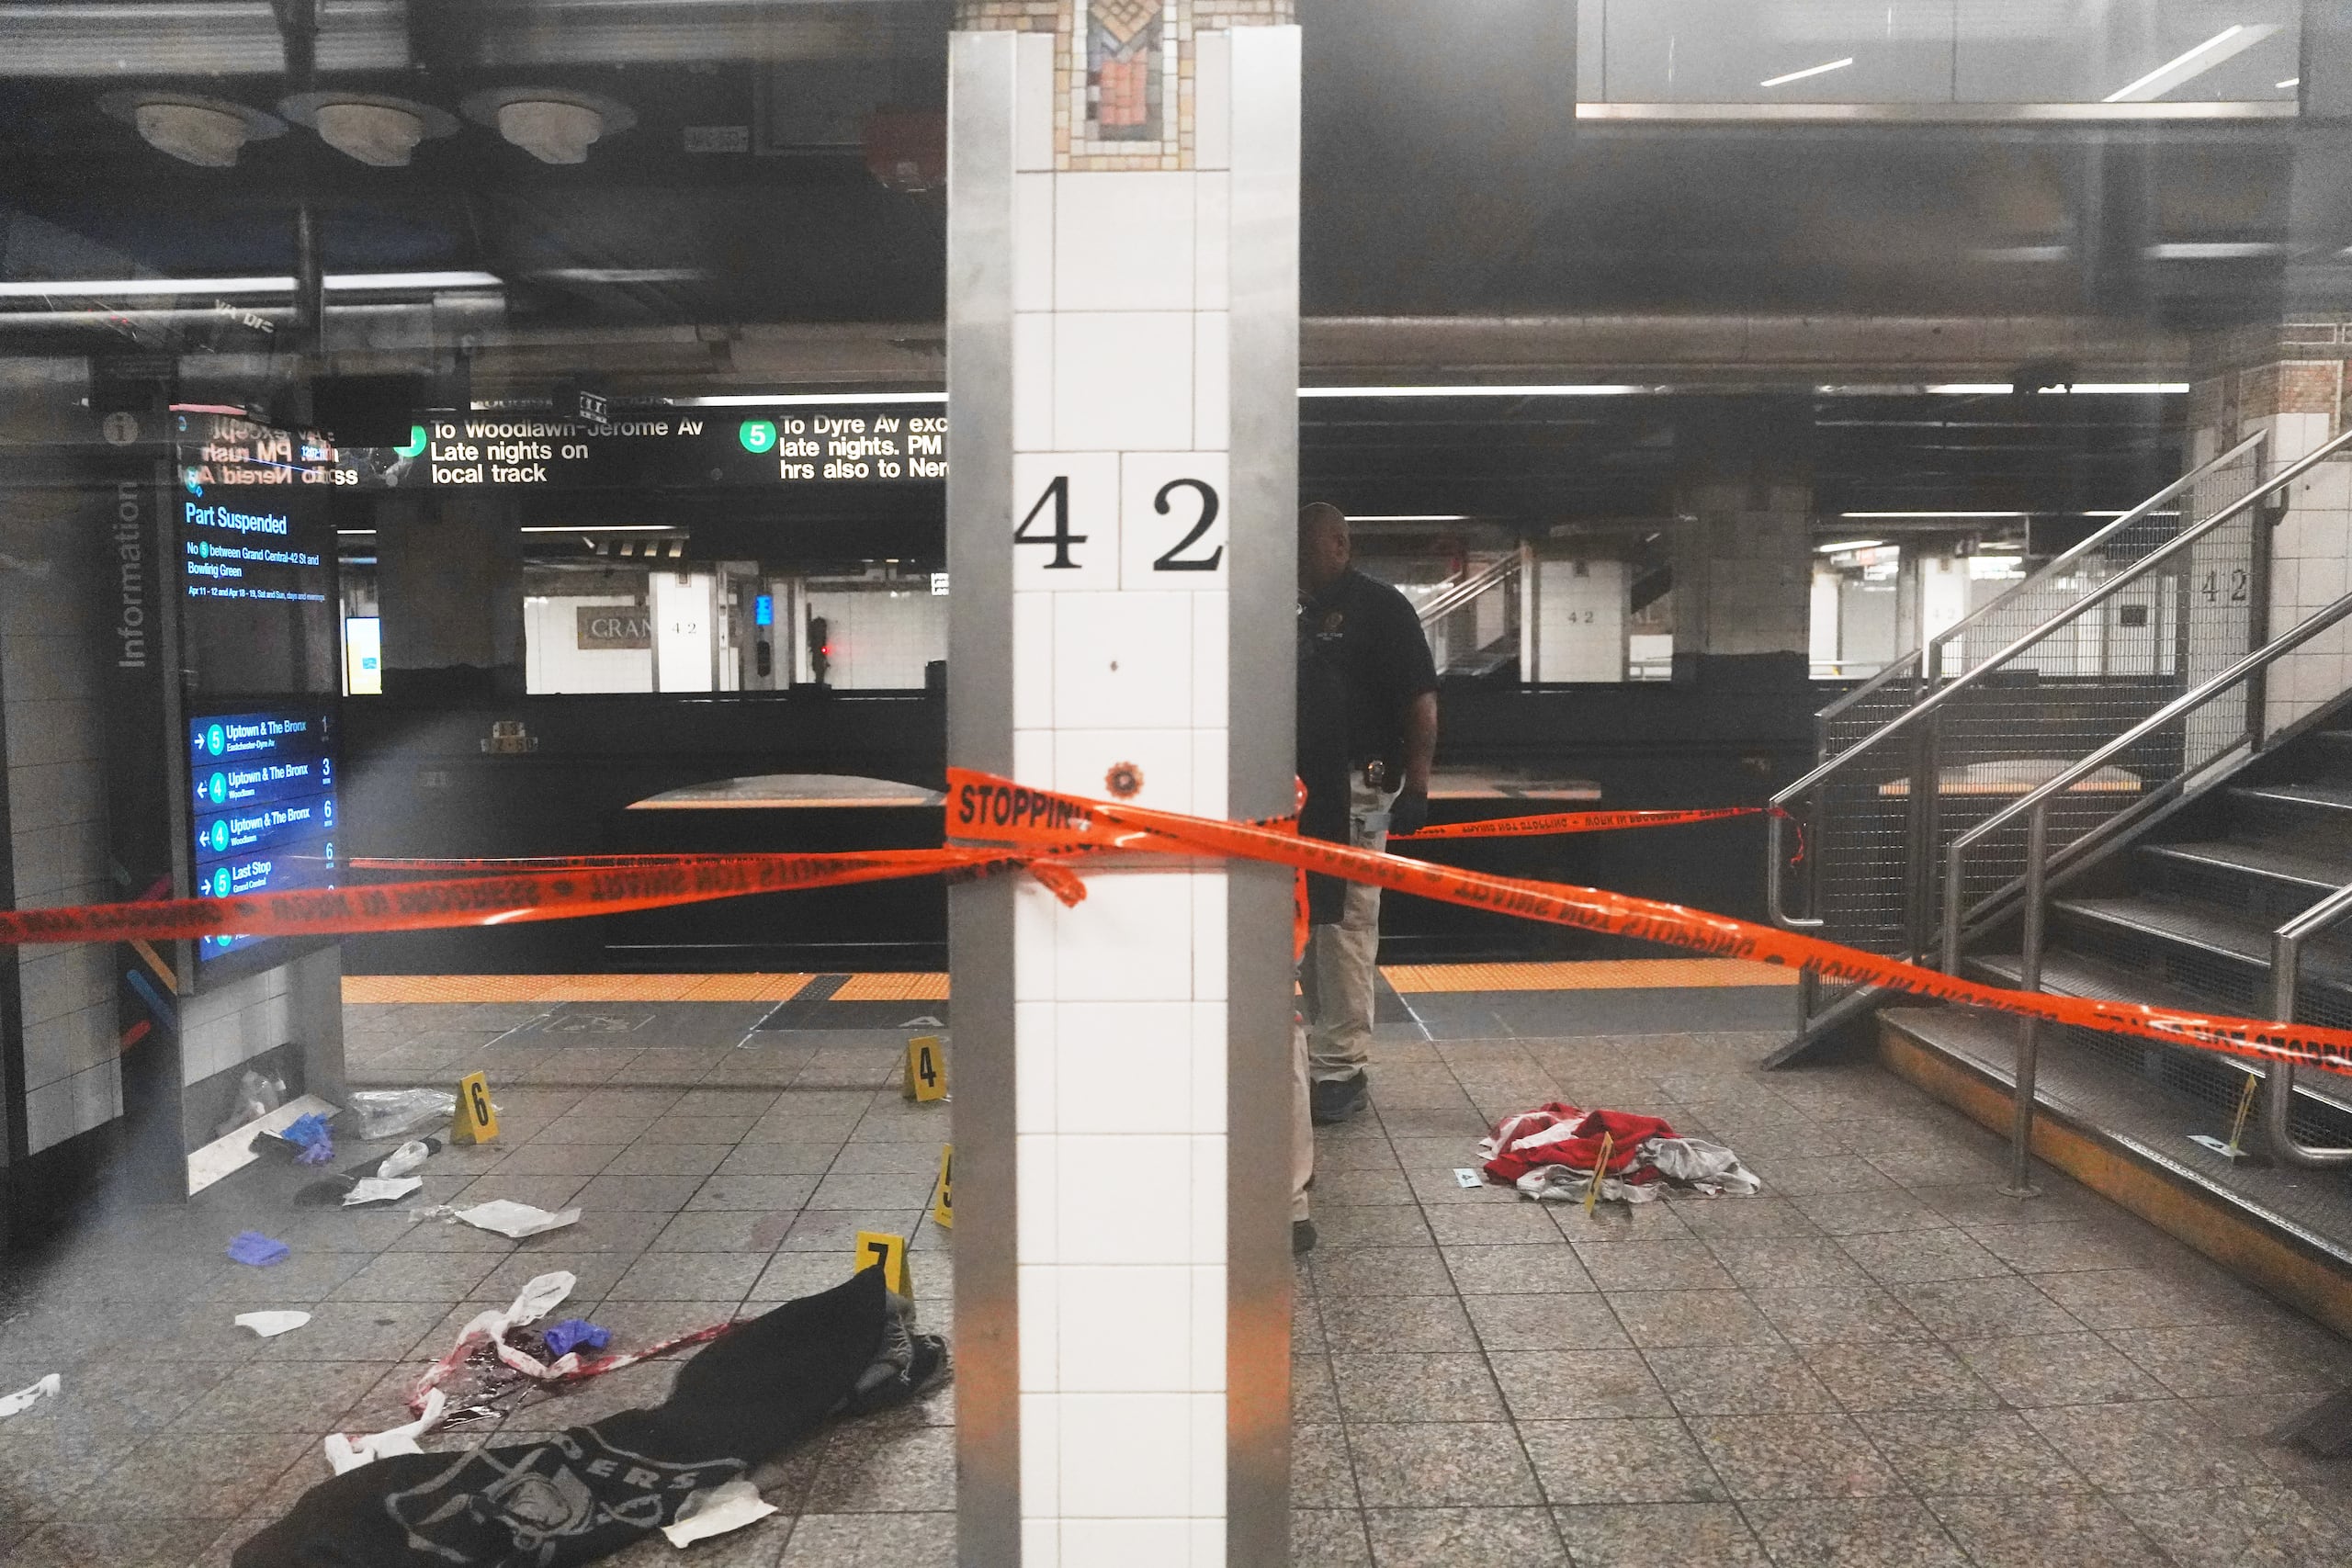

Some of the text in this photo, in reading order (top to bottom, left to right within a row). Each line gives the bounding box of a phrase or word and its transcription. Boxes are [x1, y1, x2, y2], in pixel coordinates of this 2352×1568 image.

[677, 418, 704, 436] Av
[750, 424, 765, 446] 5
[779, 415, 805, 434] To
[813, 415, 865, 436] Dyre
[873, 414, 899, 434] Av
[431, 441, 589, 464] Late nights on
[779, 434, 942, 460] late nights. PM
[431, 463, 548, 483] local track
[780, 457, 949, 479] hrs also to Ner
[186, 502, 288, 535] Part Suspended
[187, 542, 198, 555] No
[209, 545, 242, 558] between
[242, 547, 264, 560] Grand
[264, 549, 299, 563] Central-42
[299, 553, 306, 564] St
[307, 555, 320, 566] and
[112, 481, 145, 667] Information
[187, 562, 243, 579] Bowling Green
[188, 586, 199, 597] Apr
[210, 587, 218, 596] 12
[218, 588, 228, 597] and
[229, 588, 239, 599] Apr
[226, 725, 259, 741] Uptown
[260, 722, 267, 735] &
[267, 721, 283, 734] The
[284, 720, 307, 733] Bronx
[228, 773, 261, 788] Uptown
[262, 768, 268, 781] &
[269, 766, 285, 780] The
[286, 764, 309, 777] Bronx
[322, 758, 330, 775] 3
[230, 818, 263, 835] Uptown
[264, 813, 271, 827] &
[271, 811, 287, 825] The
[288, 807, 311, 822] Bronx
[324, 800, 332, 818] 6
[232, 864, 251, 880] Last
[252, 862, 272, 875] Stop
[325, 842, 333, 860] 6
[920, 1047, 937, 1088] 4
[471, 1082, 489, 1126] 6
